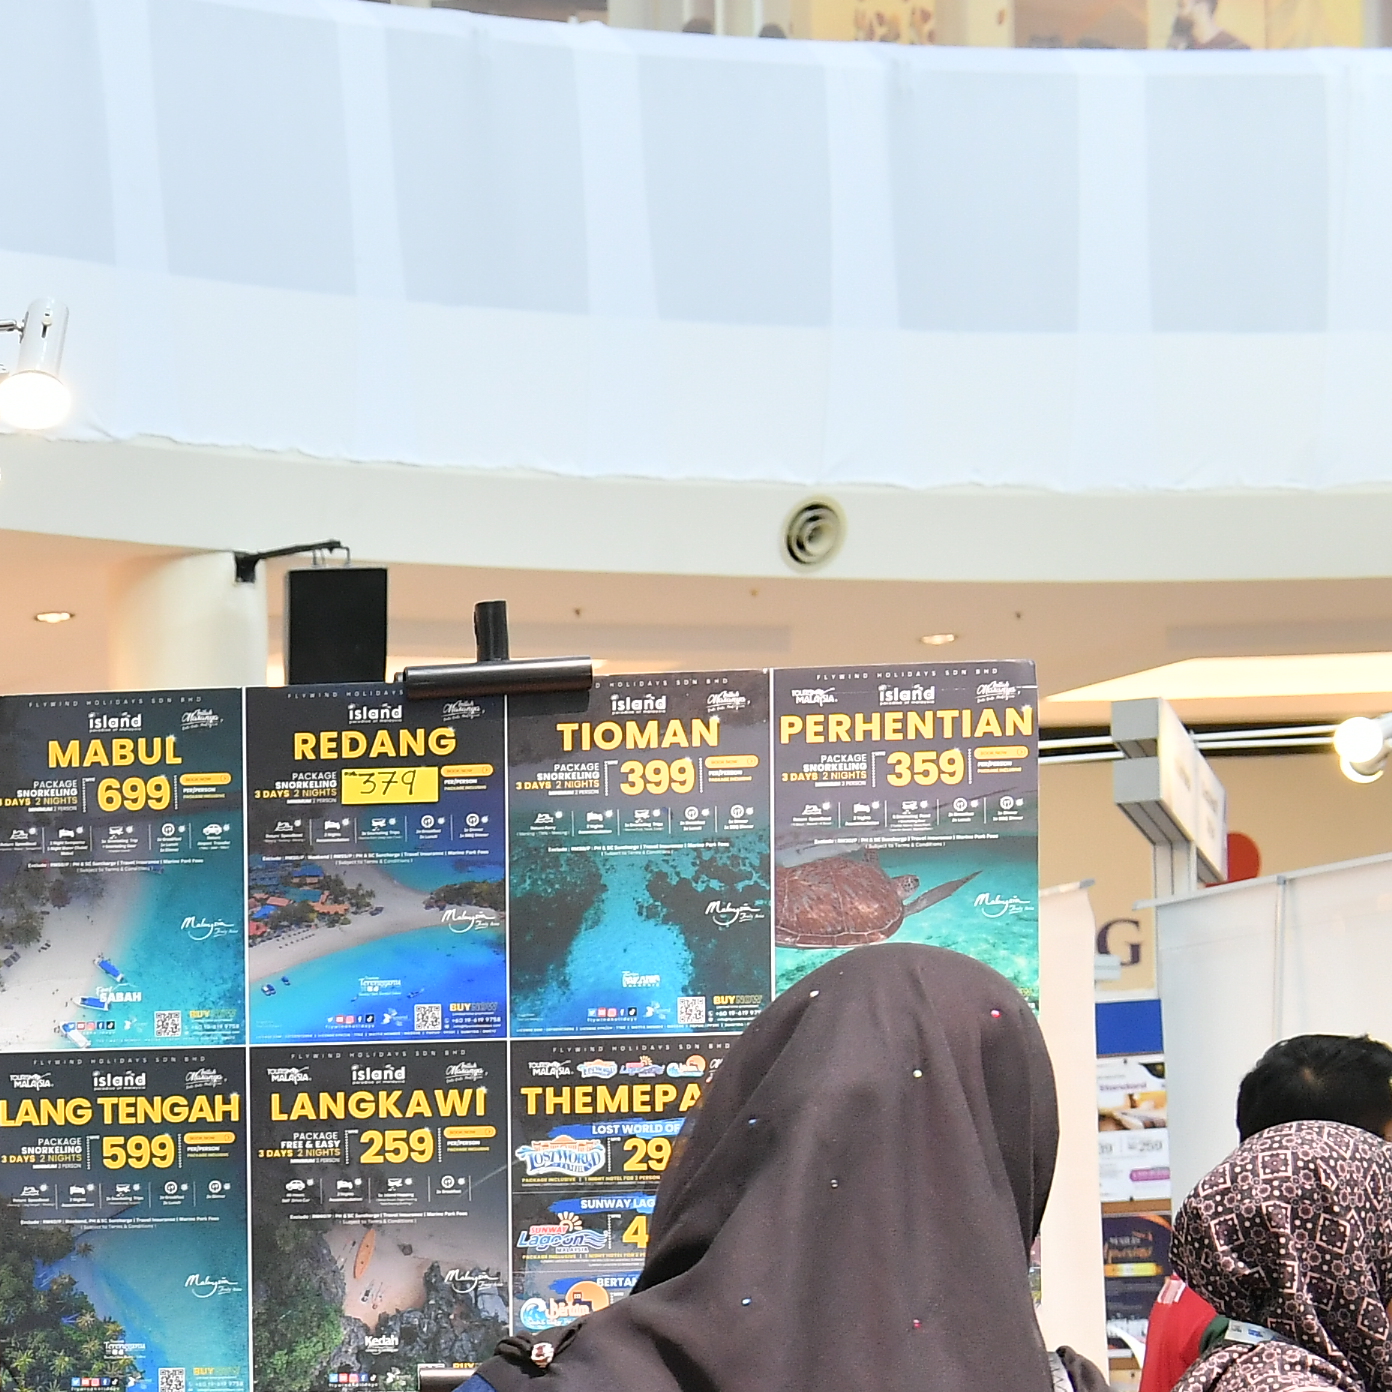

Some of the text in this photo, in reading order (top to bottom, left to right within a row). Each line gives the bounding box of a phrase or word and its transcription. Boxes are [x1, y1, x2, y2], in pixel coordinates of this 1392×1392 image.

[877, 670, 936, 678] HOLIDAYS
[348, 703, 403, 721] island
[88, 712, 142, 729] island
[780, 706, 1034, 744] PERHENTIAN
[556, 718, 720, 751] TIOMAN
[294, 727, 456, 761] REDANG
[48, 736, 182, 769] MABUL
[820, 754, 867, 763] PACKAGE
[554, 763, 600, 771] PACKAGE
[803, 763, 867, 772] SNORKELING
[886, 749, 965, 787] 359
[292, 771, 337, 780] PACKAGE
[537, 771, 600, 780] SNORKELING
[620, 758, 695, 795] 399
[790, 772, 818, 781] DAYS
[275, 780, 337, 789] SNORKELING
[359, 770, 417, 796] 379
[524, 780, 600, 789] DAYS NIGHTS
[17, 789, 77, 798] SNORKELING
[98, 776, 171, 812] 699
[263, 788, 337, 798] DAYS NIGHTS
[100, 992, 141, 1002] SABAH
[449, 1003, 471, 1012] BUY
[271, 1087, 485, 1121] LANGKAWI
[520, 1083, 701, 1115] THEMEPA
[0, 1094, 239, 1127] LANG TENGAH
[592, 1124, 681, 1135] LOST WORLD OF
[38, 1138, 82, 1146] PACKAGE
[281, 1140, 341, 1149] FREE EASY
[359, 1128, 434, 1164] 259
[102, 1134, 175, 1169] 599
[623, 1137, 672, 1172] 29
[581, 1199, 631, 1209] SUNWAY
[529, 1226, 568, 1235] SUNWAY
[518, 1230, 584, 1251] Lagoon
[365, 1336, 399, 1347] Kedah
